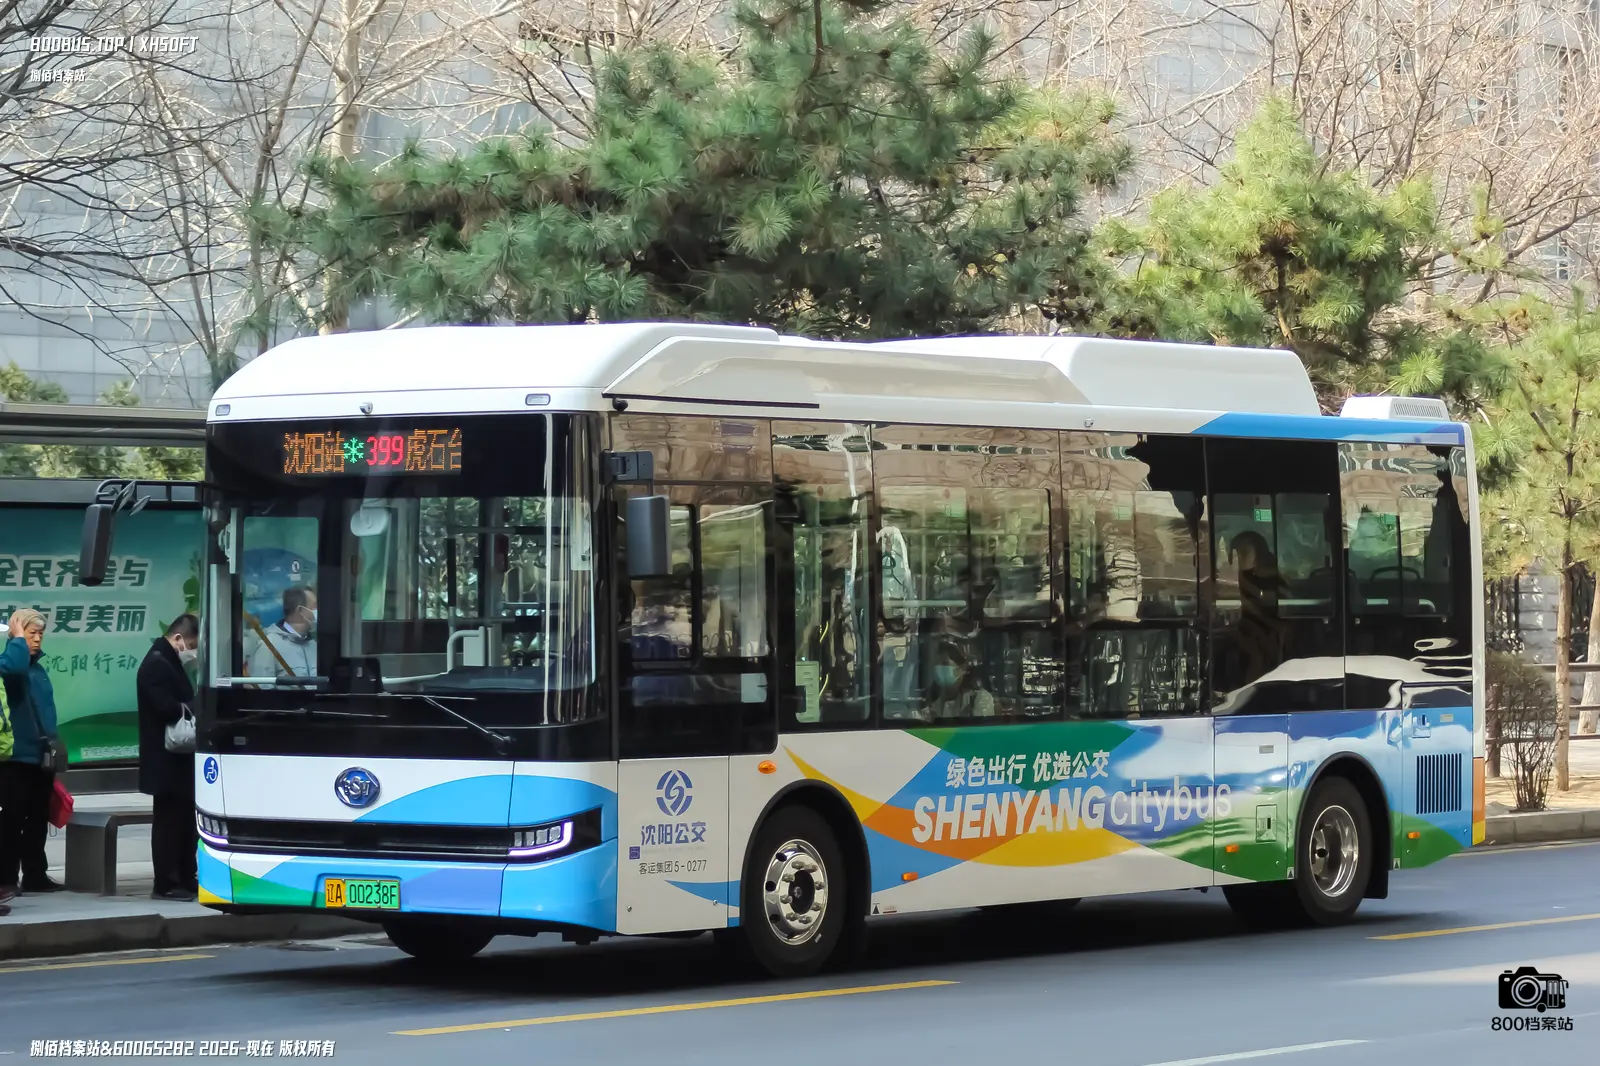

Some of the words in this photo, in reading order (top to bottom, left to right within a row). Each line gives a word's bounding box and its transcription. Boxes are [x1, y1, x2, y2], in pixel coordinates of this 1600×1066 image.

[284, 431, 345, 474] 沈阳站
[366, 435, 404, 466] 399
[405, 428, 462, 471] 虎石台
[945, 754, 1027, 788] 绿色出行
[1033, 750, 1111, 782] 优选公交
[911, 785, 1107, 844] SHENYANG
[1110, 776, 1233, 832] citybus
[641, 821, 706, 845] 沈阳公交
